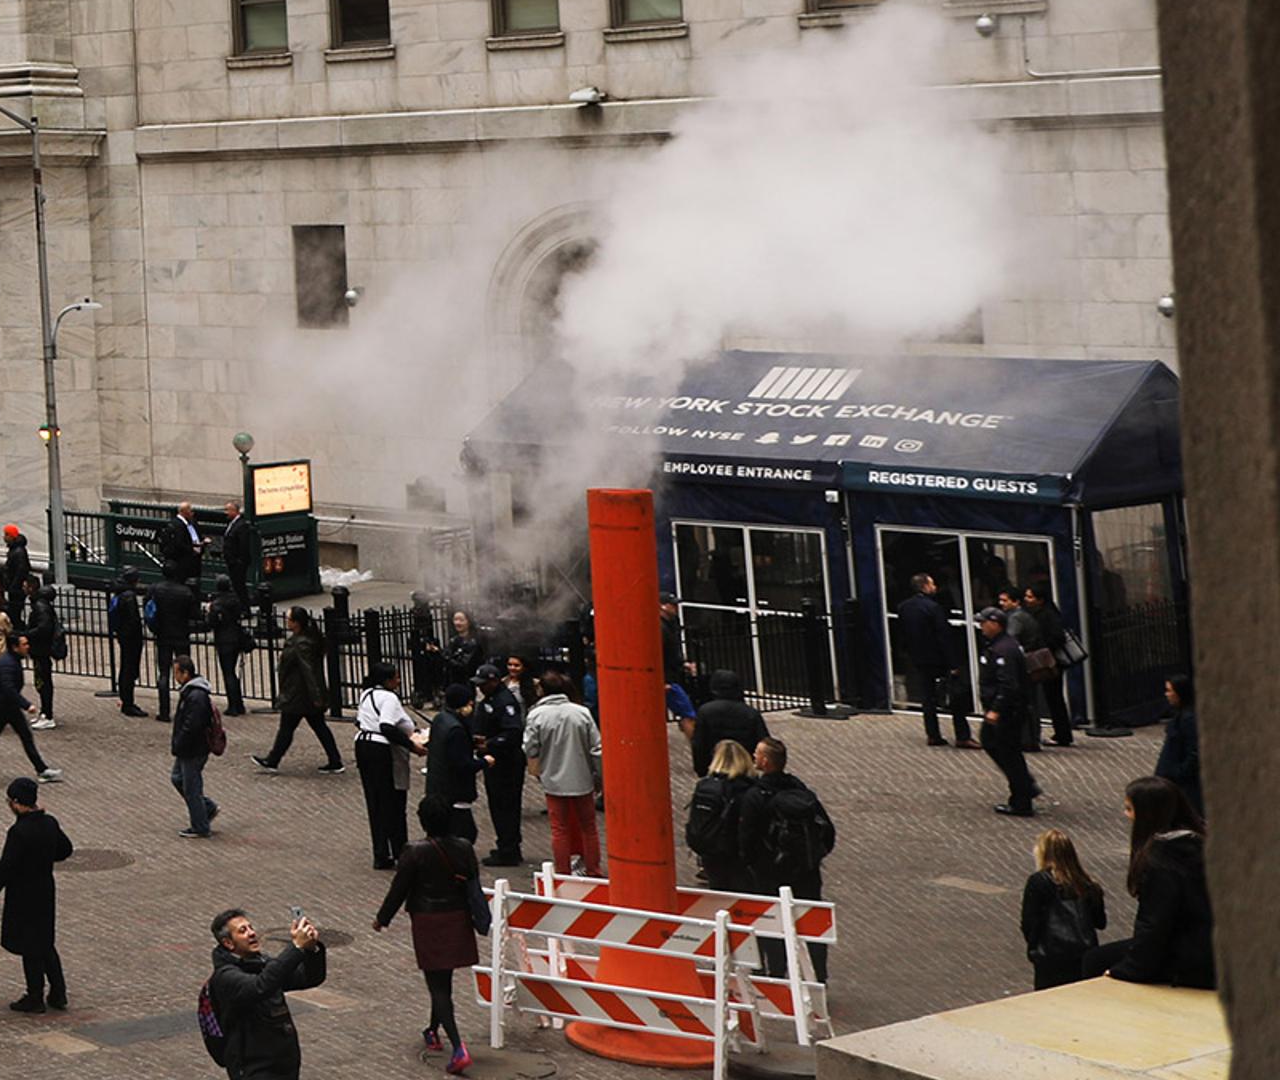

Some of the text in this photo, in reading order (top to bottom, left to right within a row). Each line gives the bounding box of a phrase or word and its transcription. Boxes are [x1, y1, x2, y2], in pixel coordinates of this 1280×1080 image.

[657, 396, 730, 414] YORK
[732, 402, 832, 419] STOCK
[834, 404, 1006, 430] EXCHANGE
[690, 429, 746, 442] NYSE
[663, 461, 813, 481] EMPLOYEE ENTRANCE
[868, 470, 1039, 495] REGISTERED GUESTS
[115, 522, 157, 540] Subway
